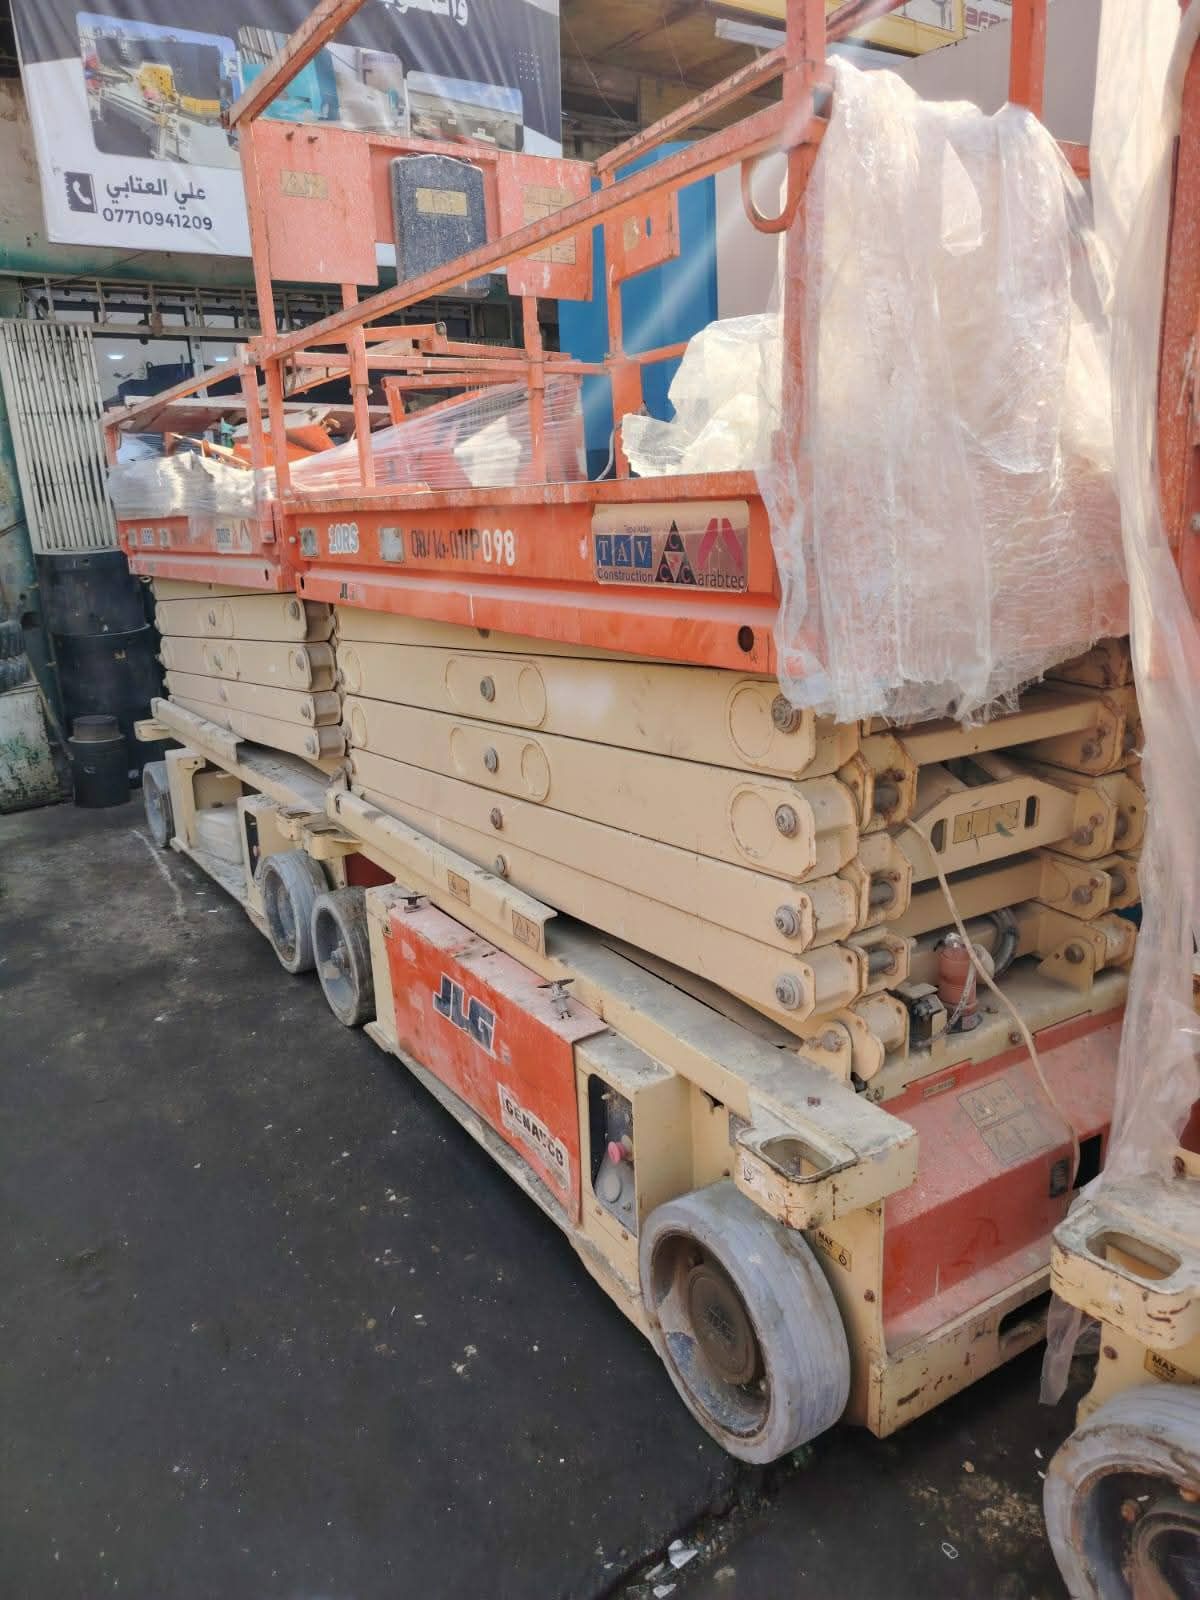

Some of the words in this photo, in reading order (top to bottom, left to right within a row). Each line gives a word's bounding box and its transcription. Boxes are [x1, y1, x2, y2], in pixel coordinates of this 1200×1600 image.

[106, 174, 168, 204] العتابي
[174, 181, 206, 210] علي
[102, 207, 213, 231] 07710941209
[597, 538, 650, 564] TAV
[597, 568, 655, 583] Construction
[698, 569, 745, 589] arabtec
[433, 971, 497, 1053] JLG
[818, 1231, 834, 1248] MAX
[1151, 1354, 1177, 1376] MAX
